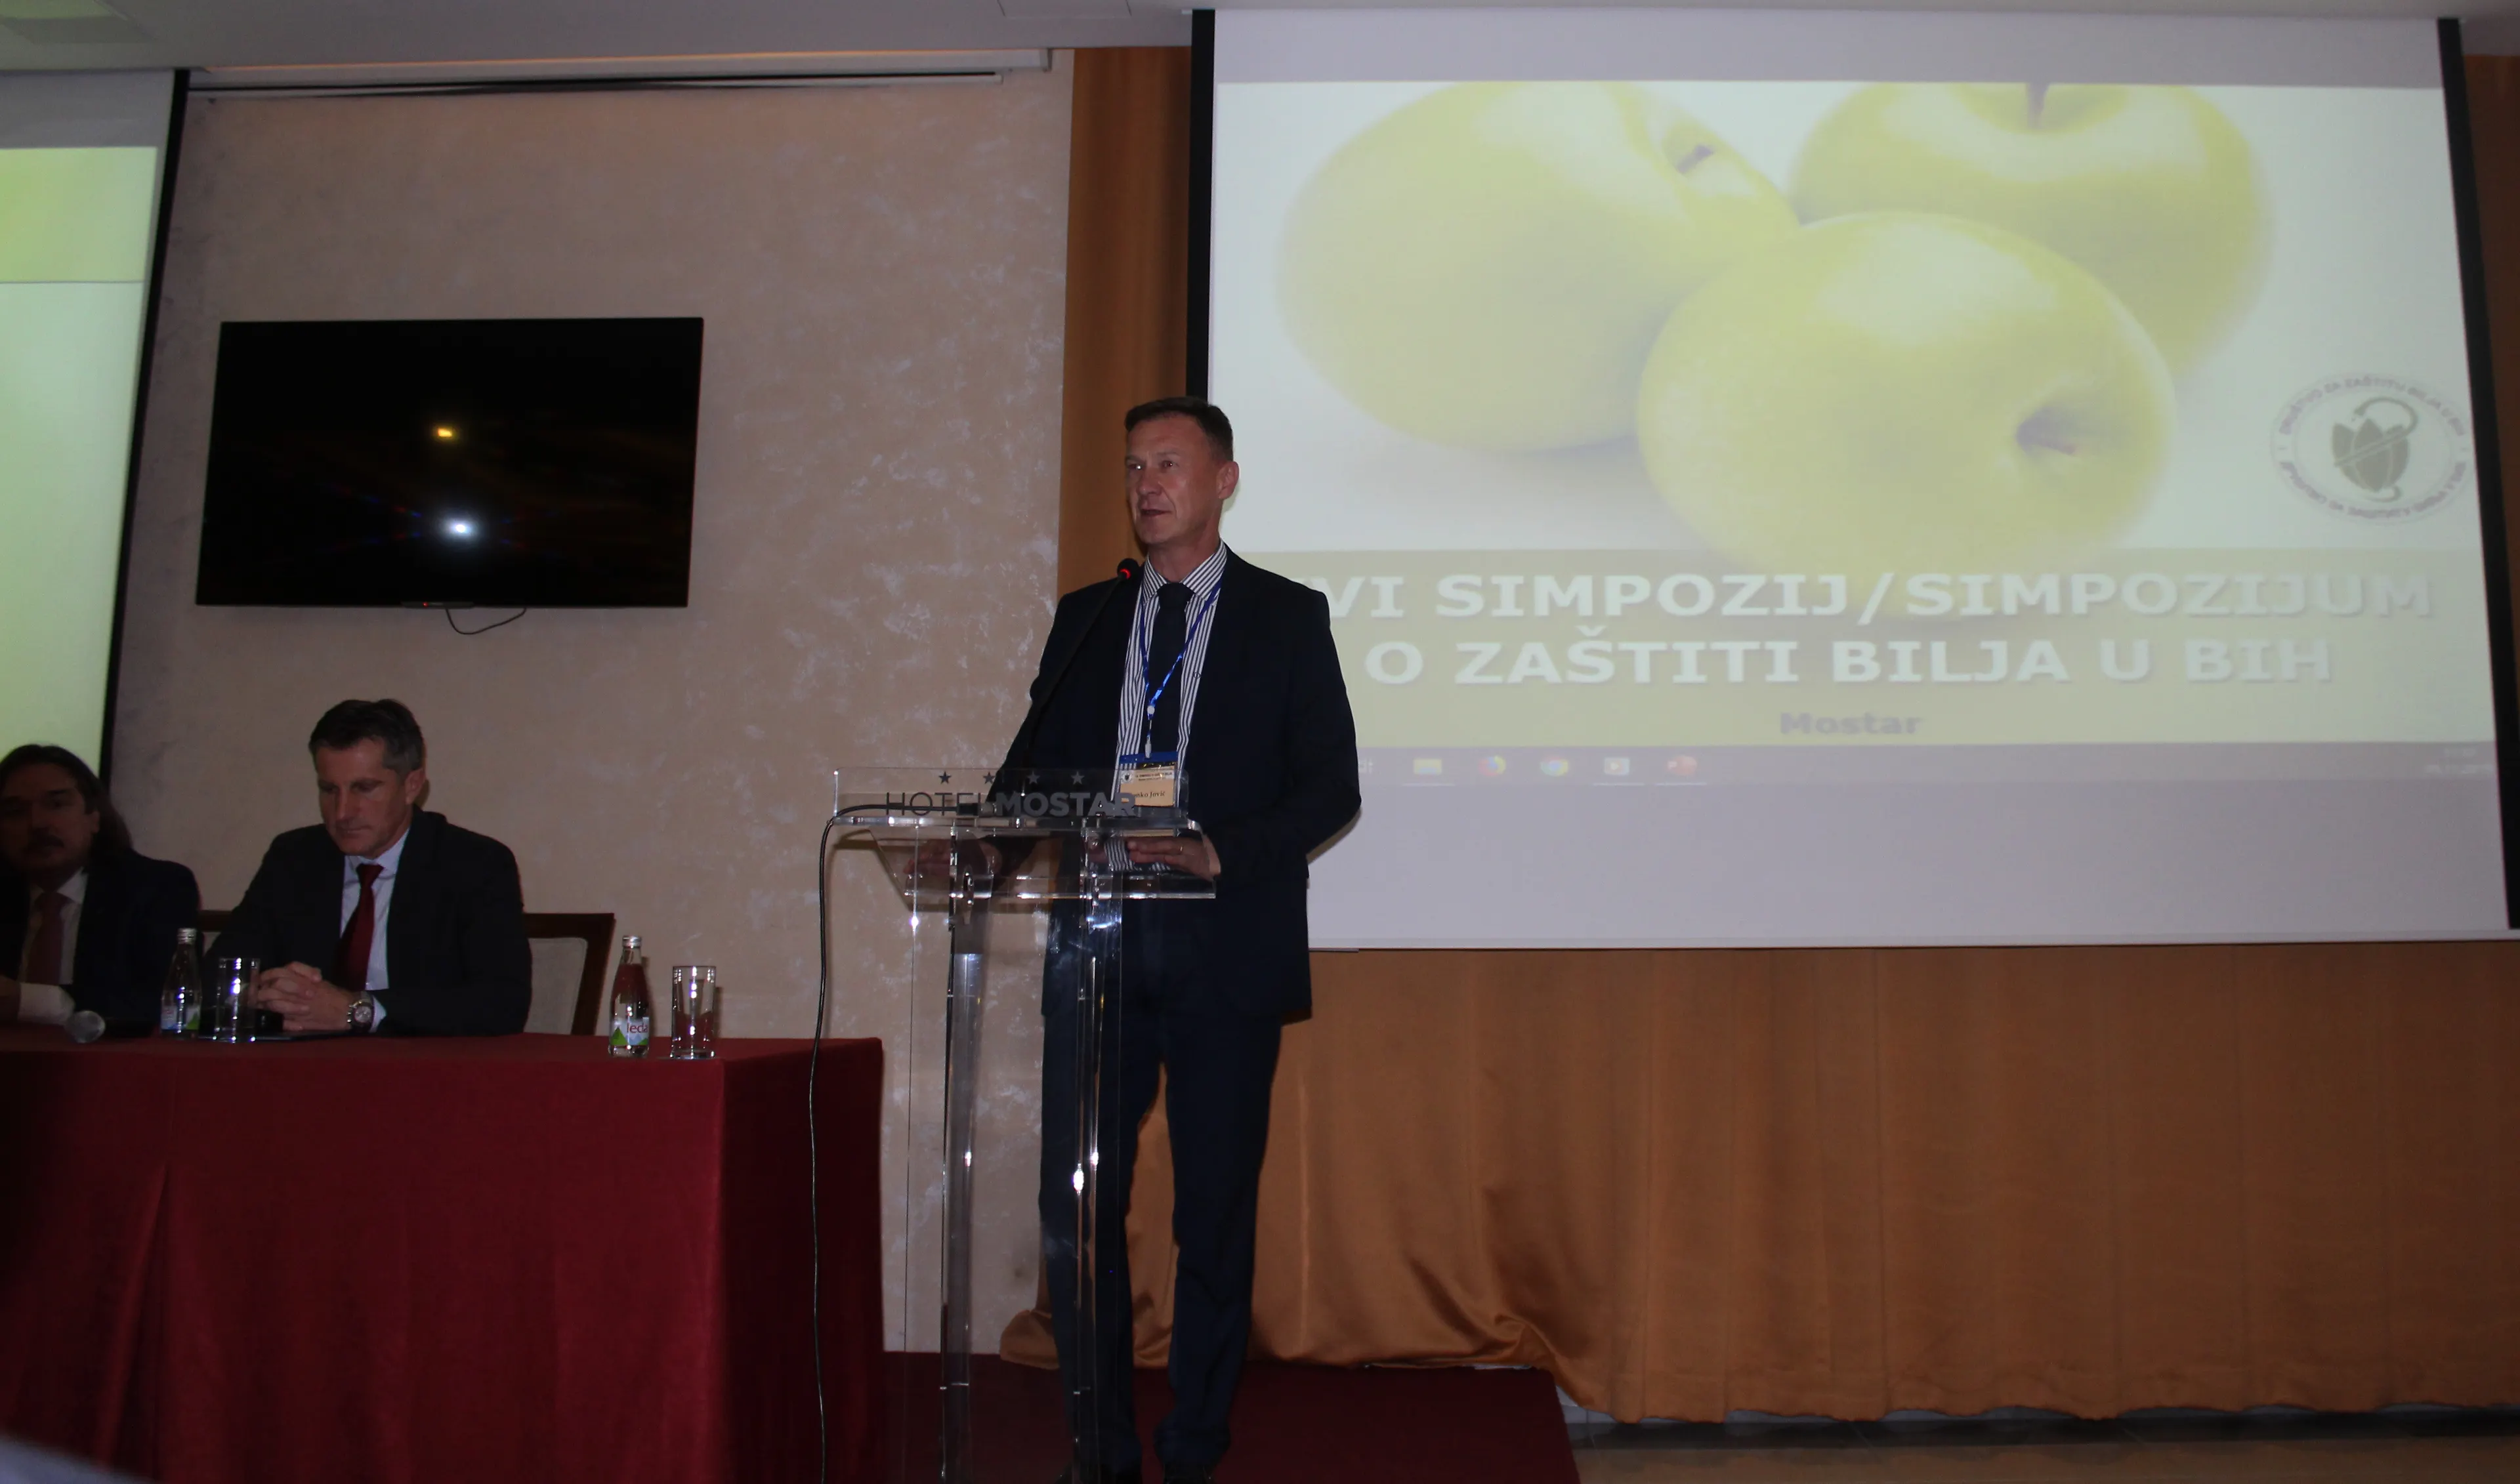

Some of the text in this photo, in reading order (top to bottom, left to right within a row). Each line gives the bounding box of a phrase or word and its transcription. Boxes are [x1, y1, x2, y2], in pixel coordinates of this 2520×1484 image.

[1290, 577, 1404, 617] VI
[1365, 625, 2332, 684] O ZAŠTITI BILJA U BIH
[1780, 711, 1922, 735] Mostar
[995, 792, 1136, 817] MOSTAR
